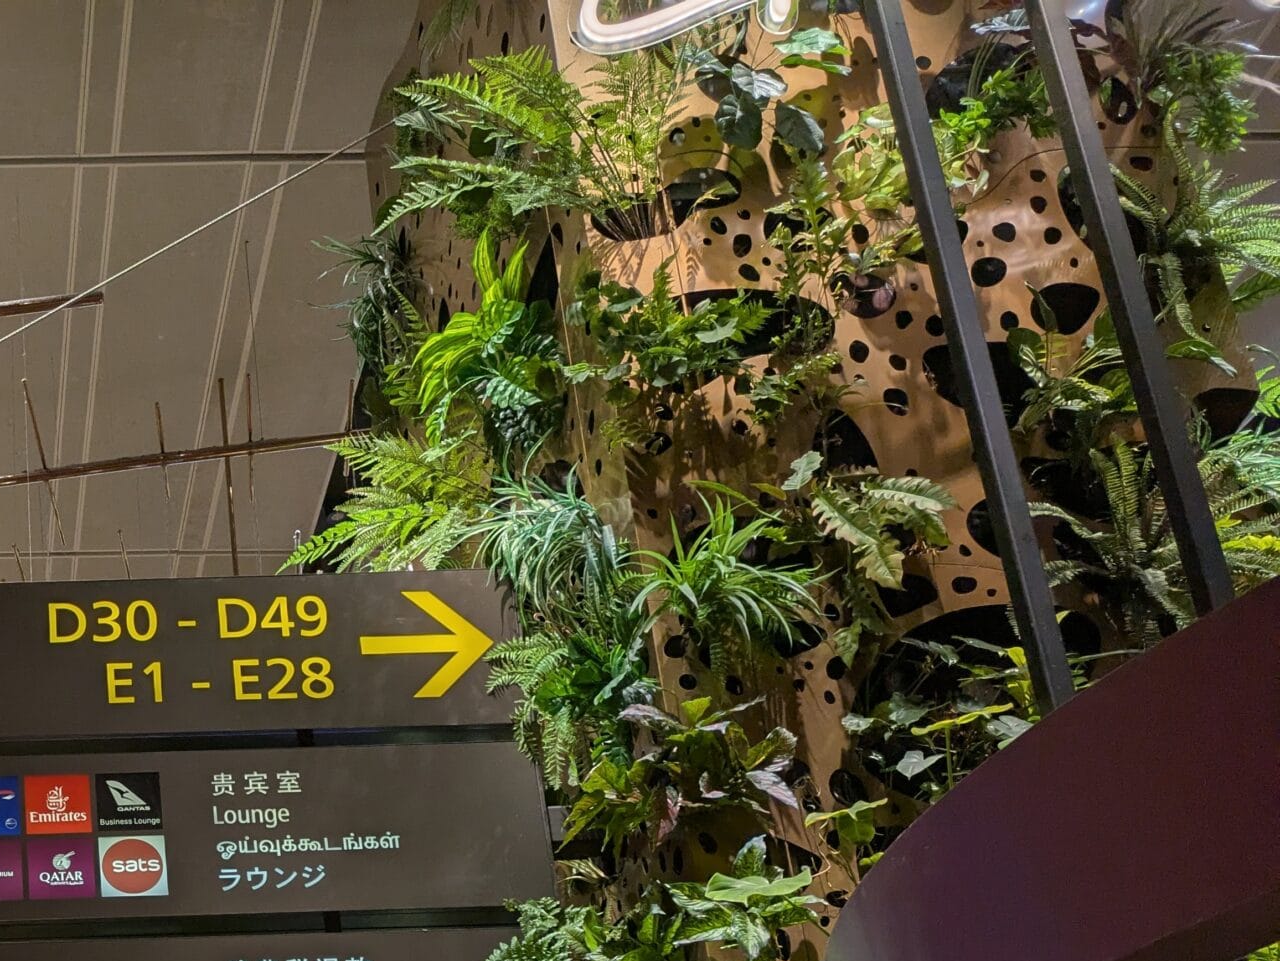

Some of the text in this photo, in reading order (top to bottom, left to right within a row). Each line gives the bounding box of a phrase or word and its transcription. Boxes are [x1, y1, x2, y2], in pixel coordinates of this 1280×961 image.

[48, 600, 158, 643] D30
[217, 595, 328, 639] D49
[106, 661, 163, 704] E1
[232, 656, 334, 700] E28
[211, 770, 302, 796] 贵宾室
[30, 811, 88, 824] Emirates
[100, 818, 161, 826] Business Lounge
[213, 805, 290, 828] Lounge
[112, 858, 161, 873] sats
[39, 871, 84, 884] QATAR
[219, 864, 326, 892] ラウンジ
